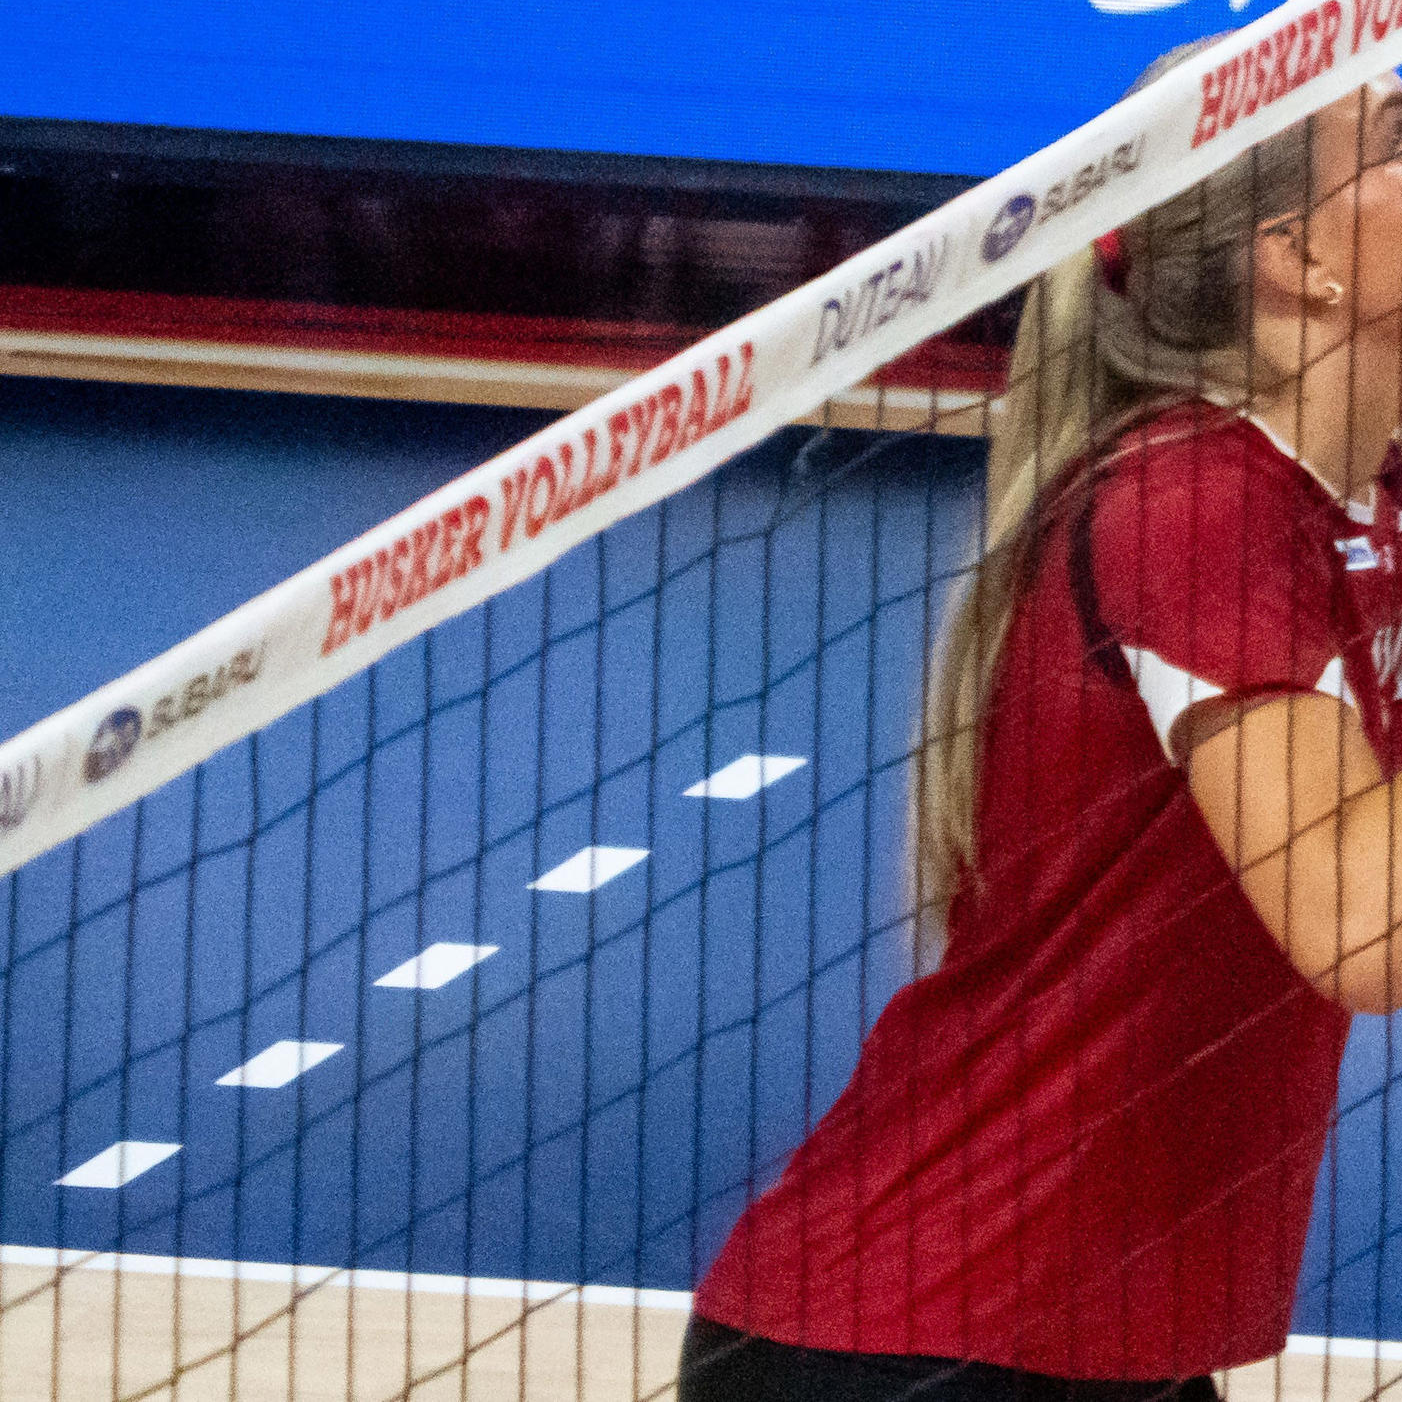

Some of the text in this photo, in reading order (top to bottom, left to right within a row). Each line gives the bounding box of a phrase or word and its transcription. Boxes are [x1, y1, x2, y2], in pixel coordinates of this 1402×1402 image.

[811, 235, 949, 368] DUTEAU
[320, 341, 755, 658] HUSKER VOLLEYBALL
